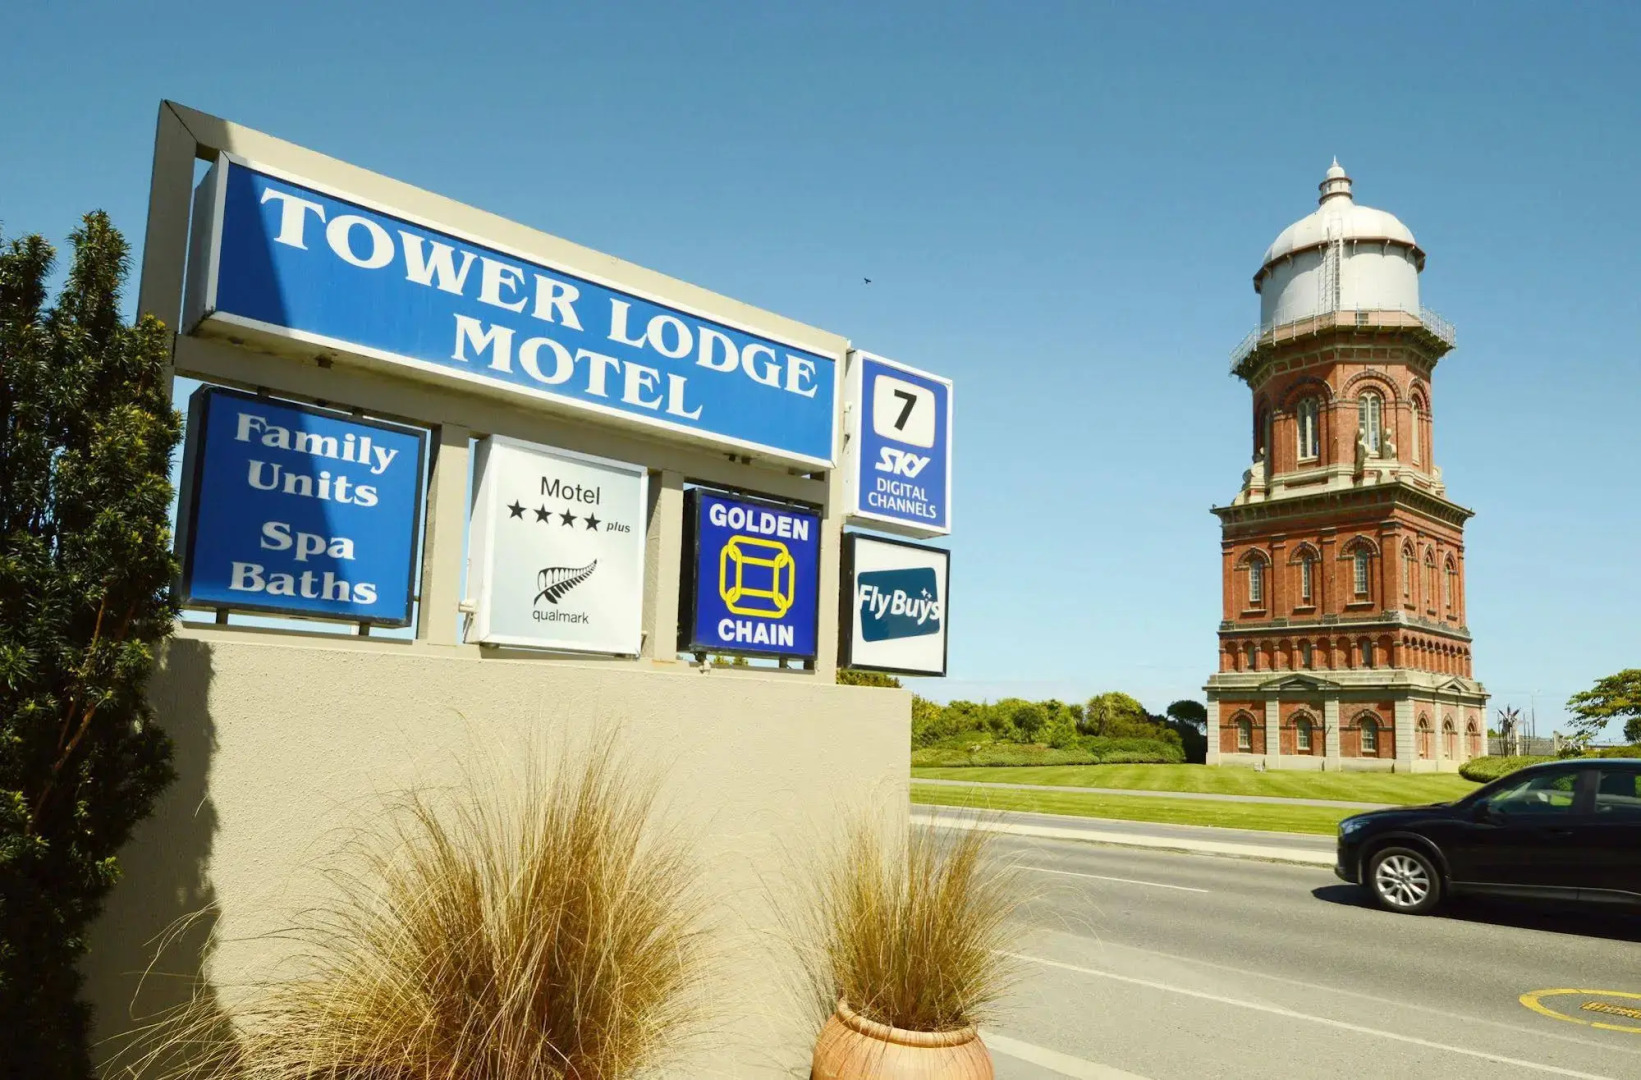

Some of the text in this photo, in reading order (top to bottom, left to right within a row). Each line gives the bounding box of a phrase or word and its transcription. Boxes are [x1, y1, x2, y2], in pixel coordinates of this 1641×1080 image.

[261, 187, 818, 398] TOWER LODGE
[451, 314, 703, 420] MOTEL
[894, 389, 917, 431] 7
[234, 412, 399, 474] Family
[875, 446, 931, 478] SKY
[248, 459, 378, 507] Units
[540, 476, 600, 505] Motel
[877, 477, 928, 502] DIGITAL
[709, 503, 809, 541] GOLDEN
[868, 492, 936, 519] CHANNELS
[260, 521, 356, 562] Spa
[606, 521, 631, 533] plus
[228, 561, 377, 604] Baths
[532, 610, 589, 624] qualmark
[718, 618, 793, 647] CHAIN
